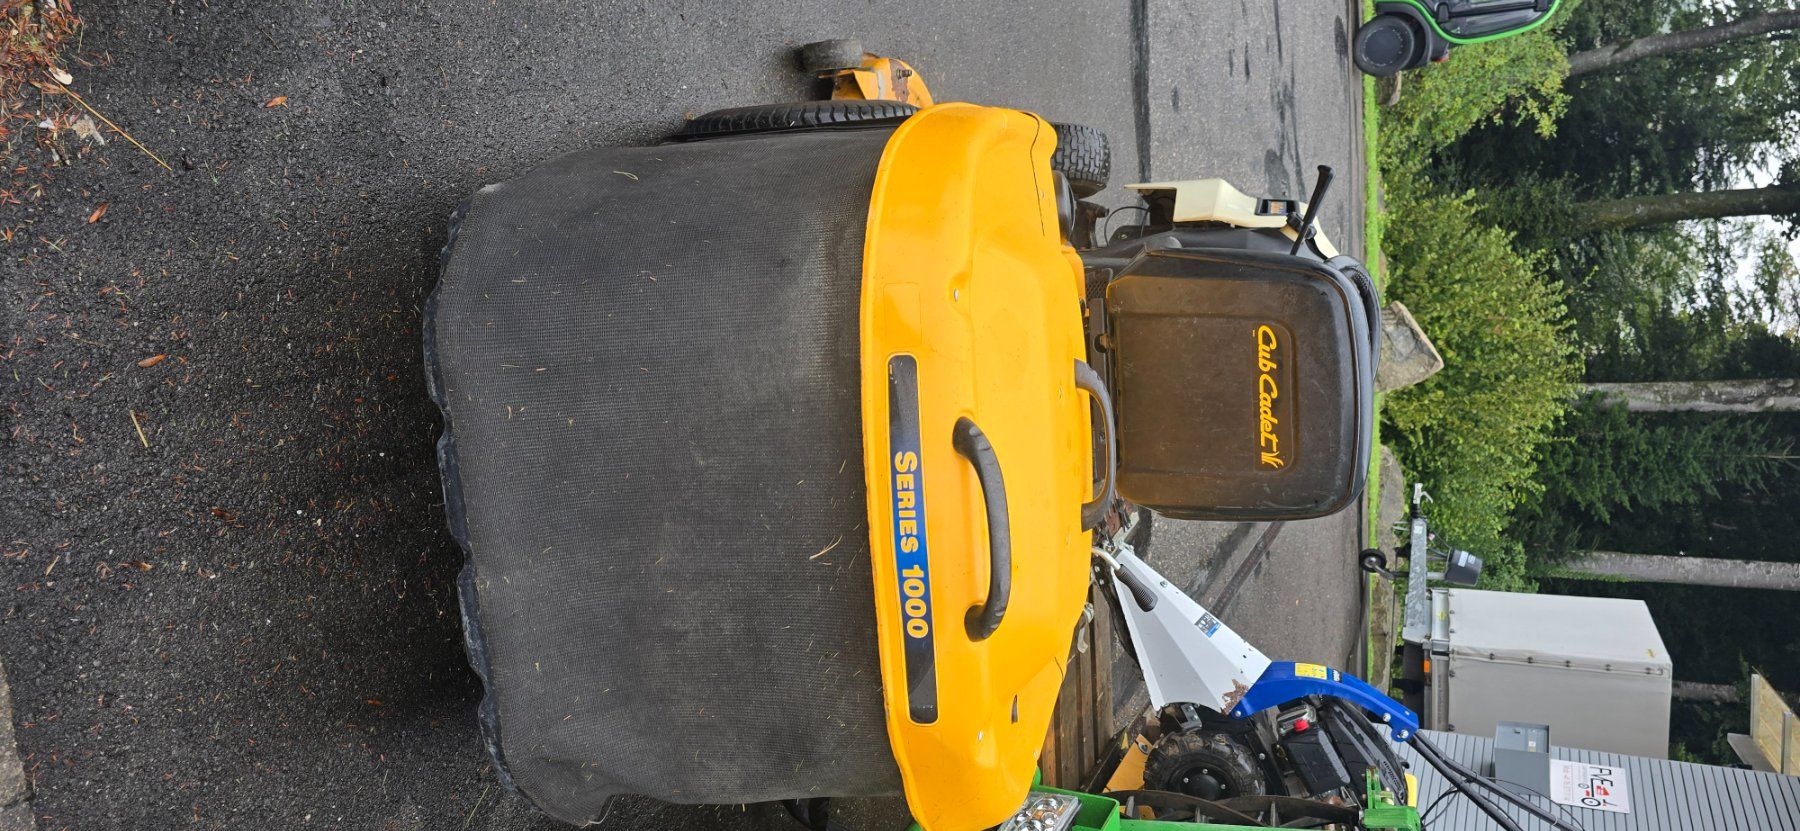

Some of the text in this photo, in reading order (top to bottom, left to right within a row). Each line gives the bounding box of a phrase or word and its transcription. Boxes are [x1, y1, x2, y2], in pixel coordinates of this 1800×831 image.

[1257, 325, 1279, 452] Cub Cadet
[893, 451, 929, 640] SERIES 1000
